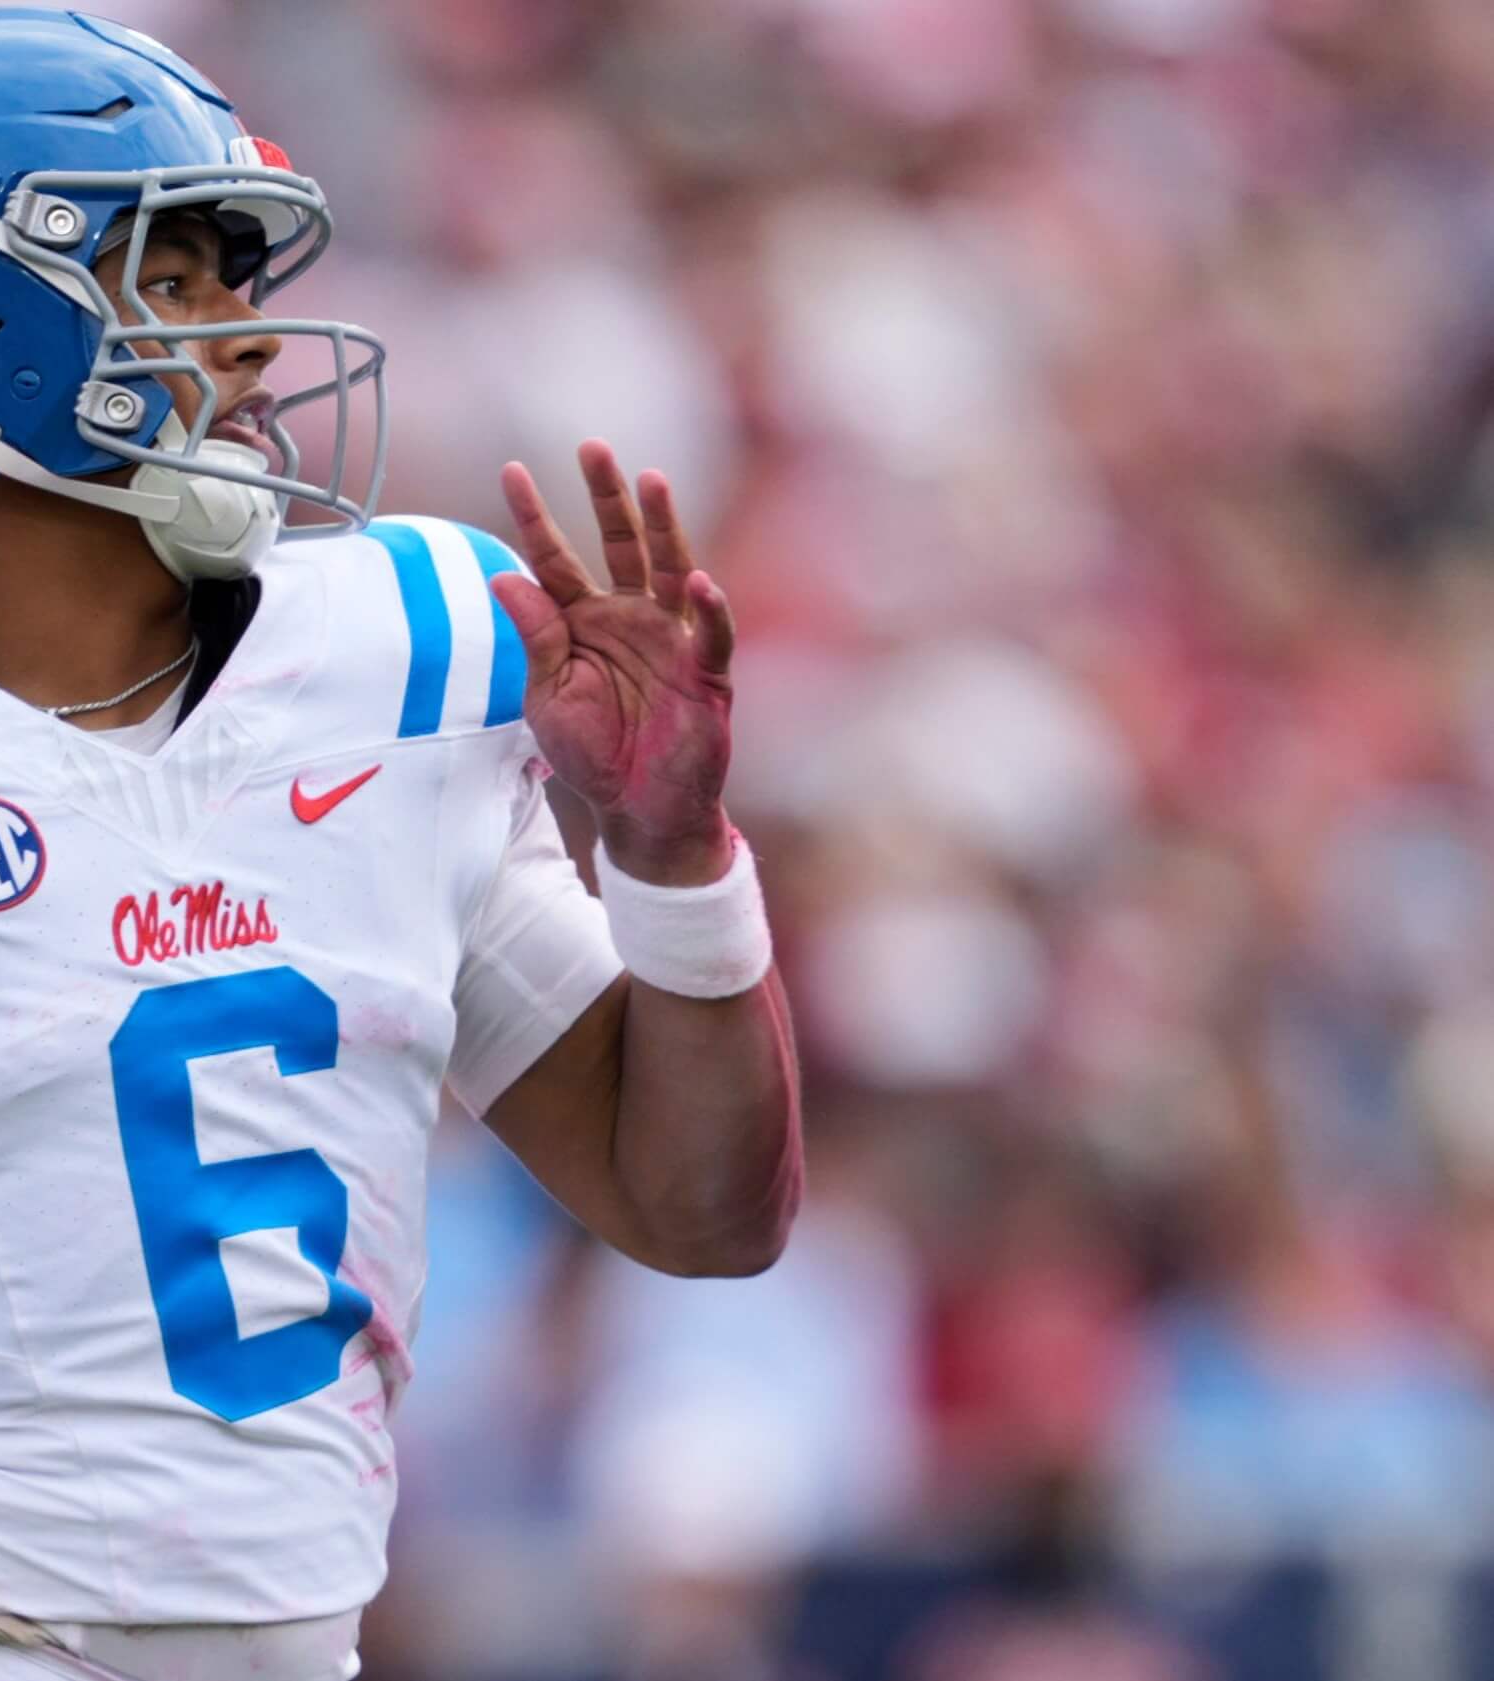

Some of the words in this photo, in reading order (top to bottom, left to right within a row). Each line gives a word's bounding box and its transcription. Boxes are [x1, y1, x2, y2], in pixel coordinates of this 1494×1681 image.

[112, 890, 180, 967] Ole
[170, 880, 278, 957] Miss
[108, 965, 374, 1423] 6
